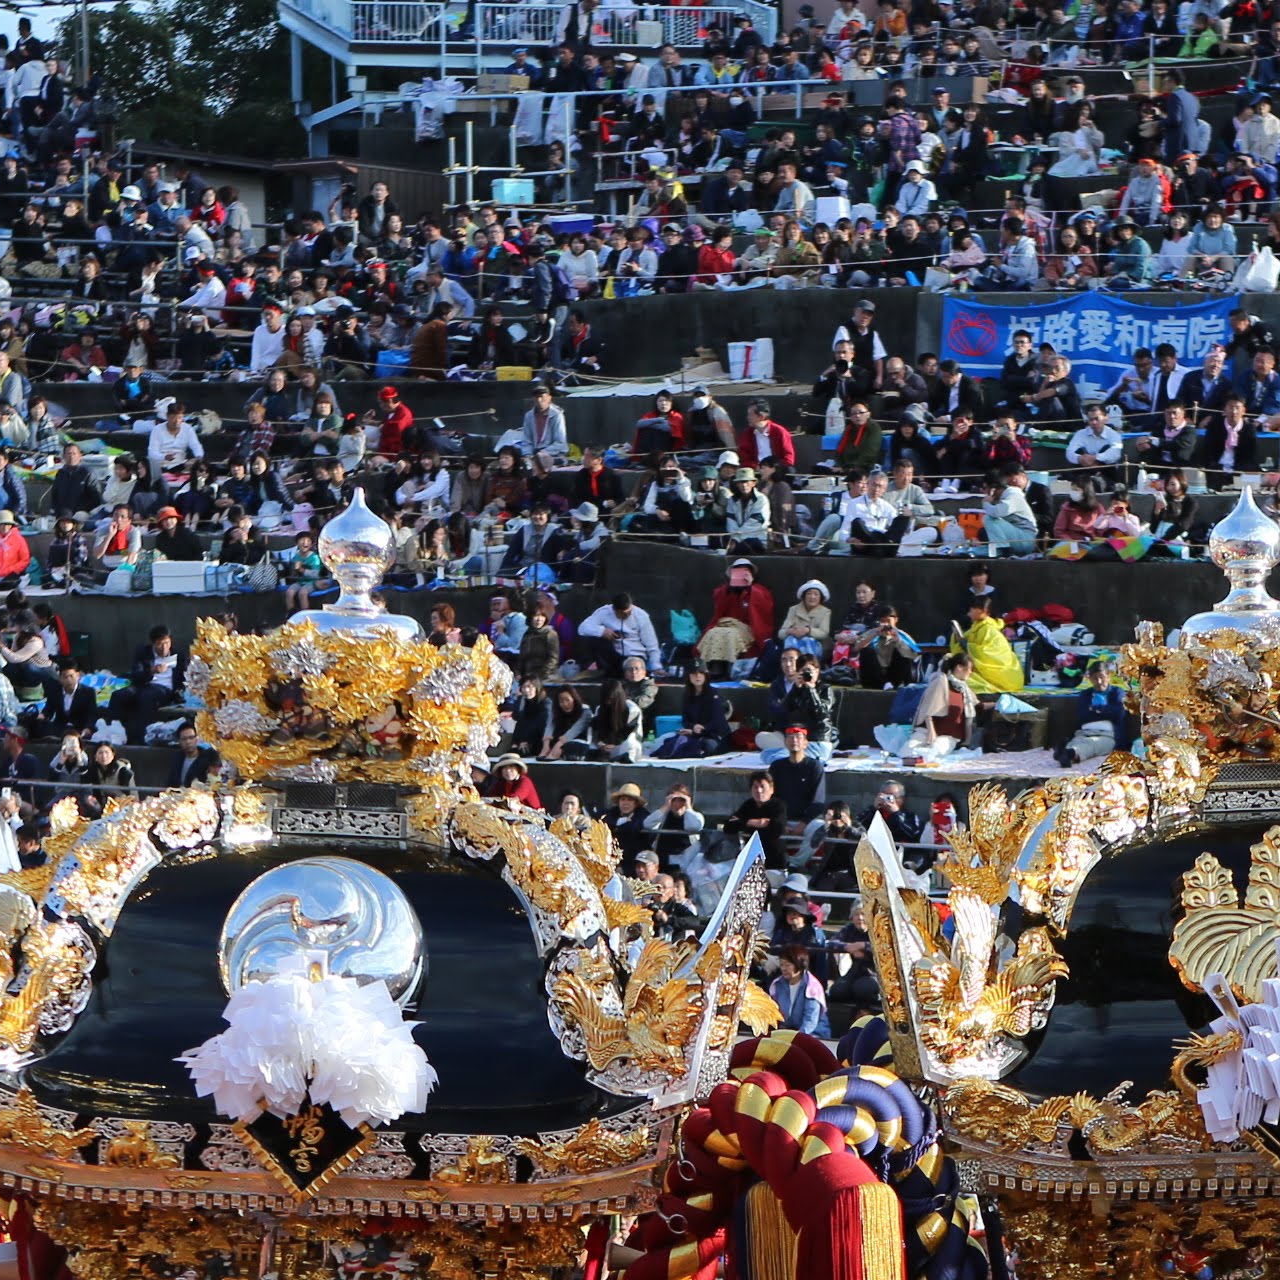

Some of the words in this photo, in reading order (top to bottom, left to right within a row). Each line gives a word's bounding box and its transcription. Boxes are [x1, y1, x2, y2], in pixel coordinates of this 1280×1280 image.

[1004, 309, 1225, 359] 姫路愛和病院
